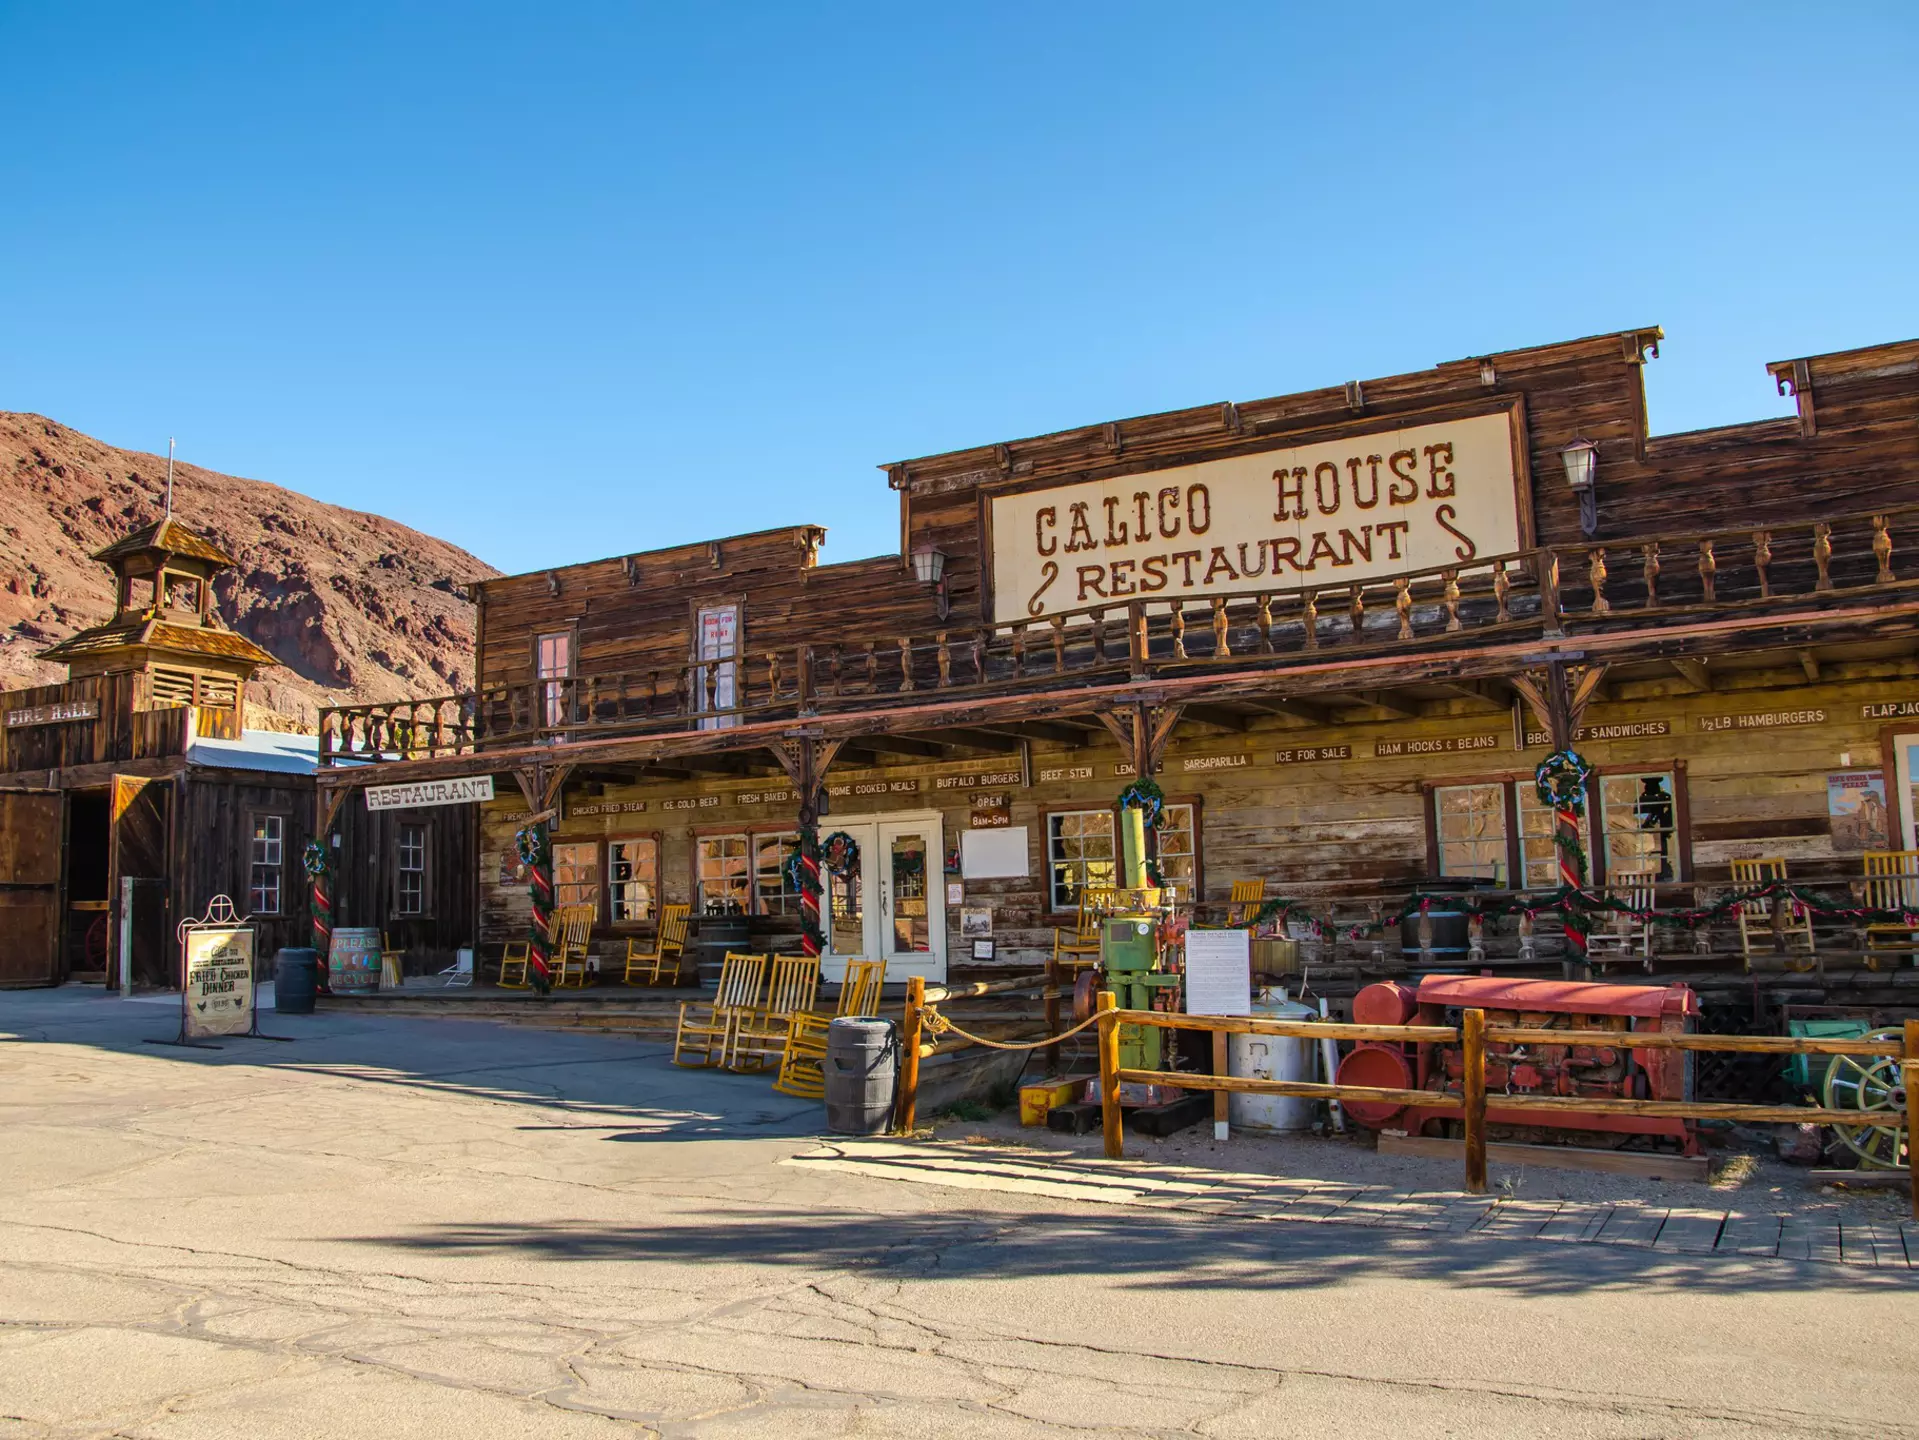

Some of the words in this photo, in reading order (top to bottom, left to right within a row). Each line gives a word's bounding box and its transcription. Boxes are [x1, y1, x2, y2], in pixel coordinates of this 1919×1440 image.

[1035, 482, 1211, 557] CALICO
[1272, 441, 1456, 522] HOUSE
[1077, 520, 1410, 601] RESTAURANT
[721, 615, 732, 624] FOR
[710, 629, 728, 638] RENT
[9, 707, 43, 726] FIRE
[51, 702, 91, 720] HALL
[1738, 709, 1825, 728] HAMBURGERS
[1591, 722, 1665, 739] SANDWICHES
[1378, 743, 1401, 755] HAM
[1407, 740, 1442, 753] HOCKS
[1458, 736, 1495, 749] BEANS
[1276, 751, 1292, 762] ICE
[1297, 749, 1316, 760] FOR
[1322, 747, 1347, 759] SALE
[1184, 755, 1247, 770] SARSAPARILLA
[936, 776, 975, 789] BUFFALO
[981, 773, 1020, 785] BURGERS
[1040, 769, 1063, 781] BEEF
[1069, 767, 1093, 778] STEW
[368, 780, 490, 807] RESTAURANT
[829, 786, 851, 797] HOME
[855, 782, 887, 795] COOKED
[890, 780, 916, 792] MEALS
[663, 800, 675, 810] ICE
[677, 799, 696, 809] COLD
[700, 797, 719, 807] BEER
[737, 795, 760, 804] FRESH
[764, 792, 788, 802] BAKED
[977, 795, 1003, 808] OPEN
[503, 811, 534, 821] FIREHOUS
[572, 805, 599, 816] CHICKEN
[601, 803, 620, 813] FRIED
[623, 802, 645, 812] STEAK
[972, 814, 1008, 826] 8AM-5PM
